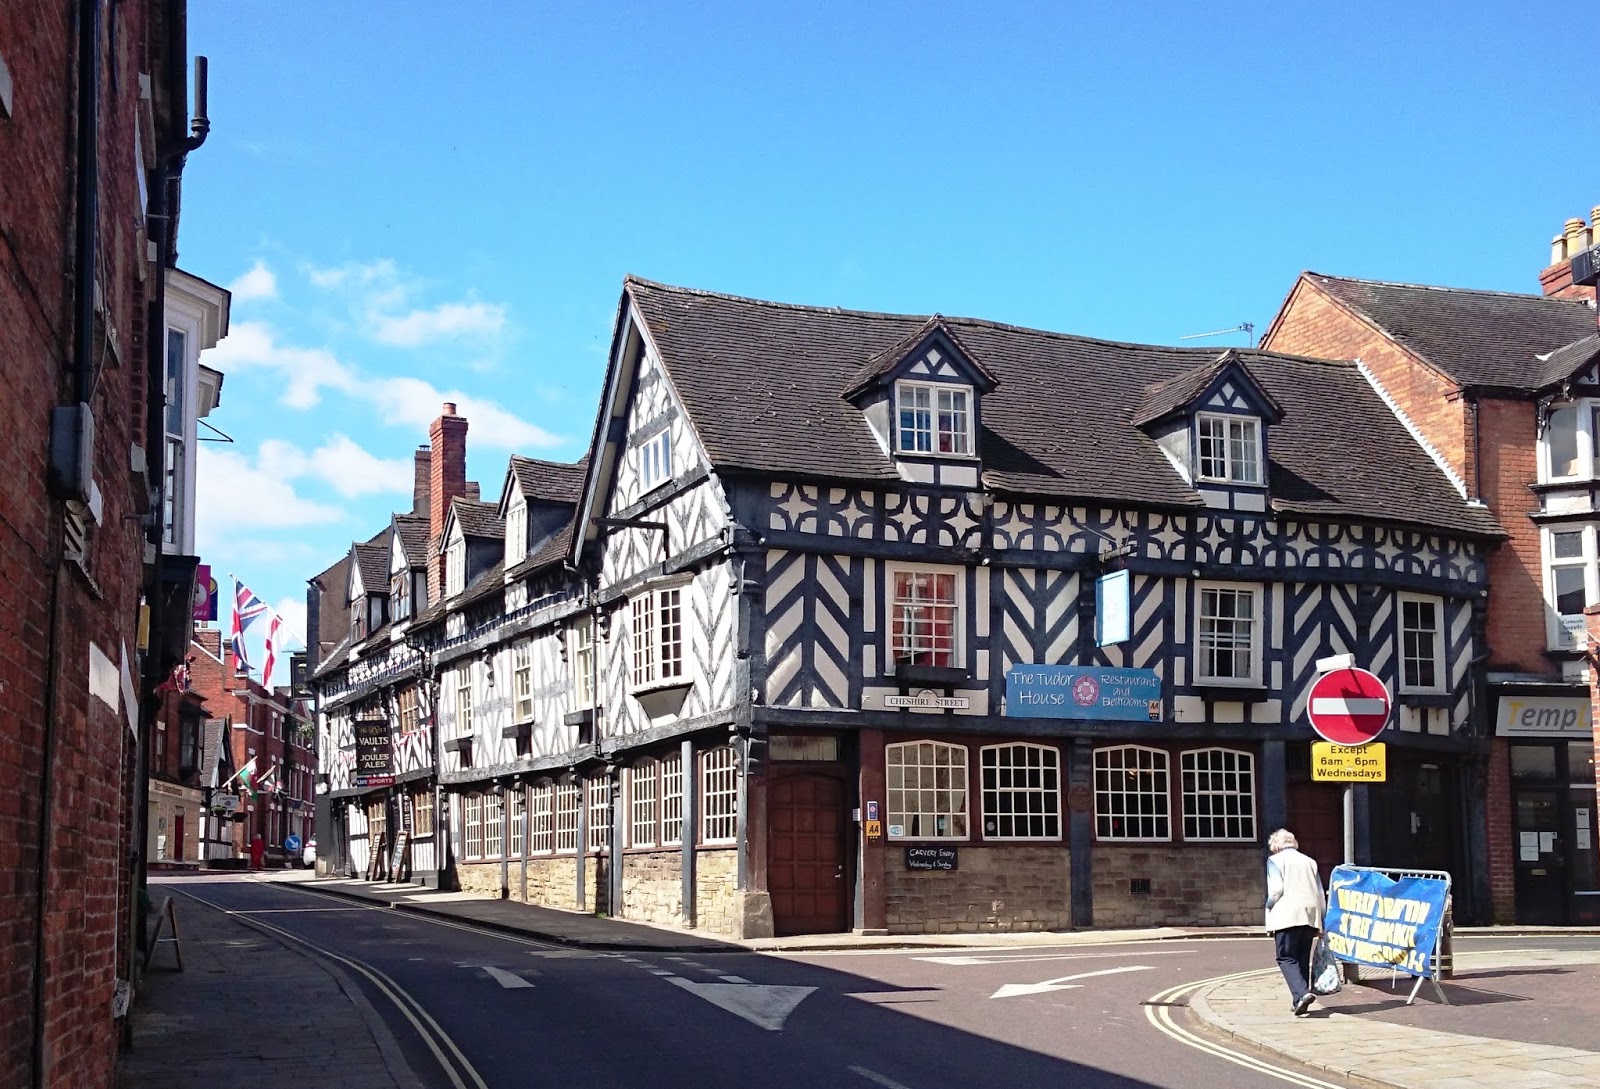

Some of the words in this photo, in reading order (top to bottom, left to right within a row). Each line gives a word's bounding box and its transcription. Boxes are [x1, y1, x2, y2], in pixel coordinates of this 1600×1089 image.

[1011, 671, 1034, 685] The
[1036, 672, 1075, 686] Tudor
[1101, 674, 1157, 687] Restaurant
[1112, 687, 1130, 697] and
[890, 697, 931, 706] CHESHIRE
[935, 699, 964, 707] STREET
[1019, 690, 1065, 705] House
[1102, 696, 1148, 708] Bedrooms
[1150, 702, 1158, 710] AA
[359, 736, 389, 746] VAULTS
[1330, 745, 1367, 755] Except
[360, 753, 389, 762] JOULES
[1320, 757, 1343, 766] 6am
[1355, 757, 1378, 767] 6pm
[364, 761, 386, 769] ALES
[1317, 768, 1382, 779] Wednesdays
[869, 824, 879, 834] AA
